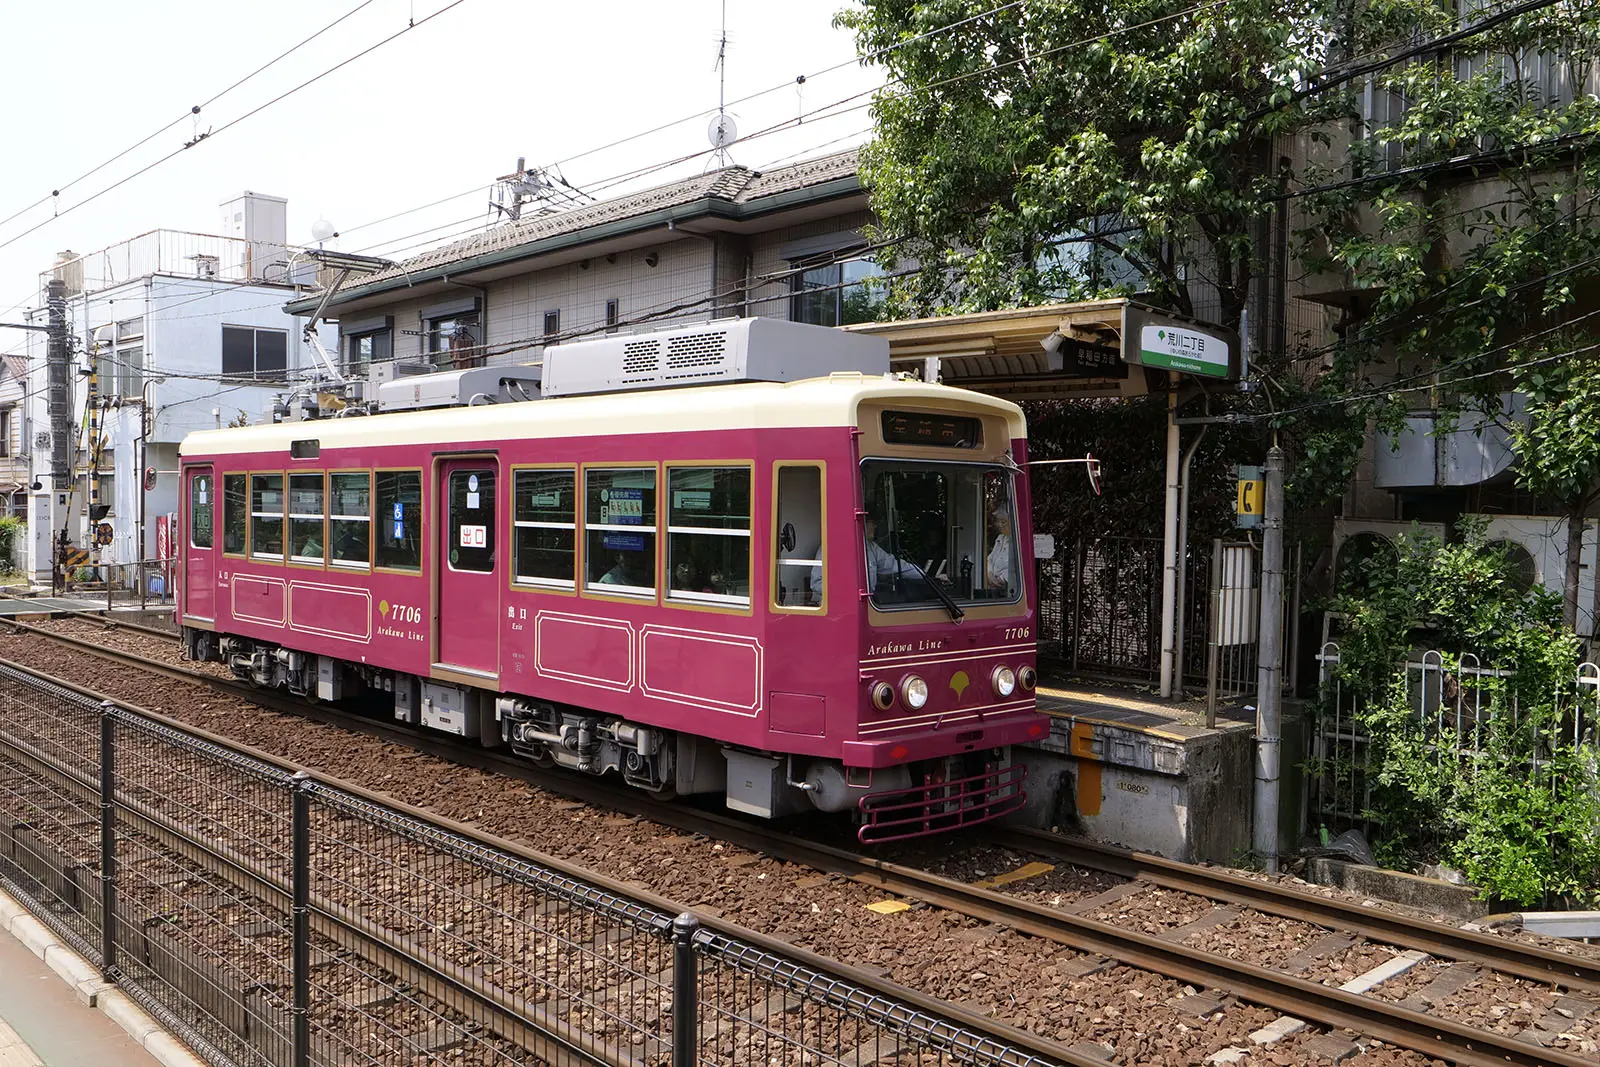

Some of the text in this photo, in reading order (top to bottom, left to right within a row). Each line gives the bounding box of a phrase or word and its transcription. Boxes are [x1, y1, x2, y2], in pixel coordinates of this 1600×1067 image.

[1167, 332, 1205, 352] 荒川二丁目
[462, 527, 484, 545] 出口
[392, 604, 421, 624] 7706
[377, 626, 424, 642] Arakawa Line
[1004, 626, 1030, 640] 7706
[867, 639, 943, 656] Arakawa Line
